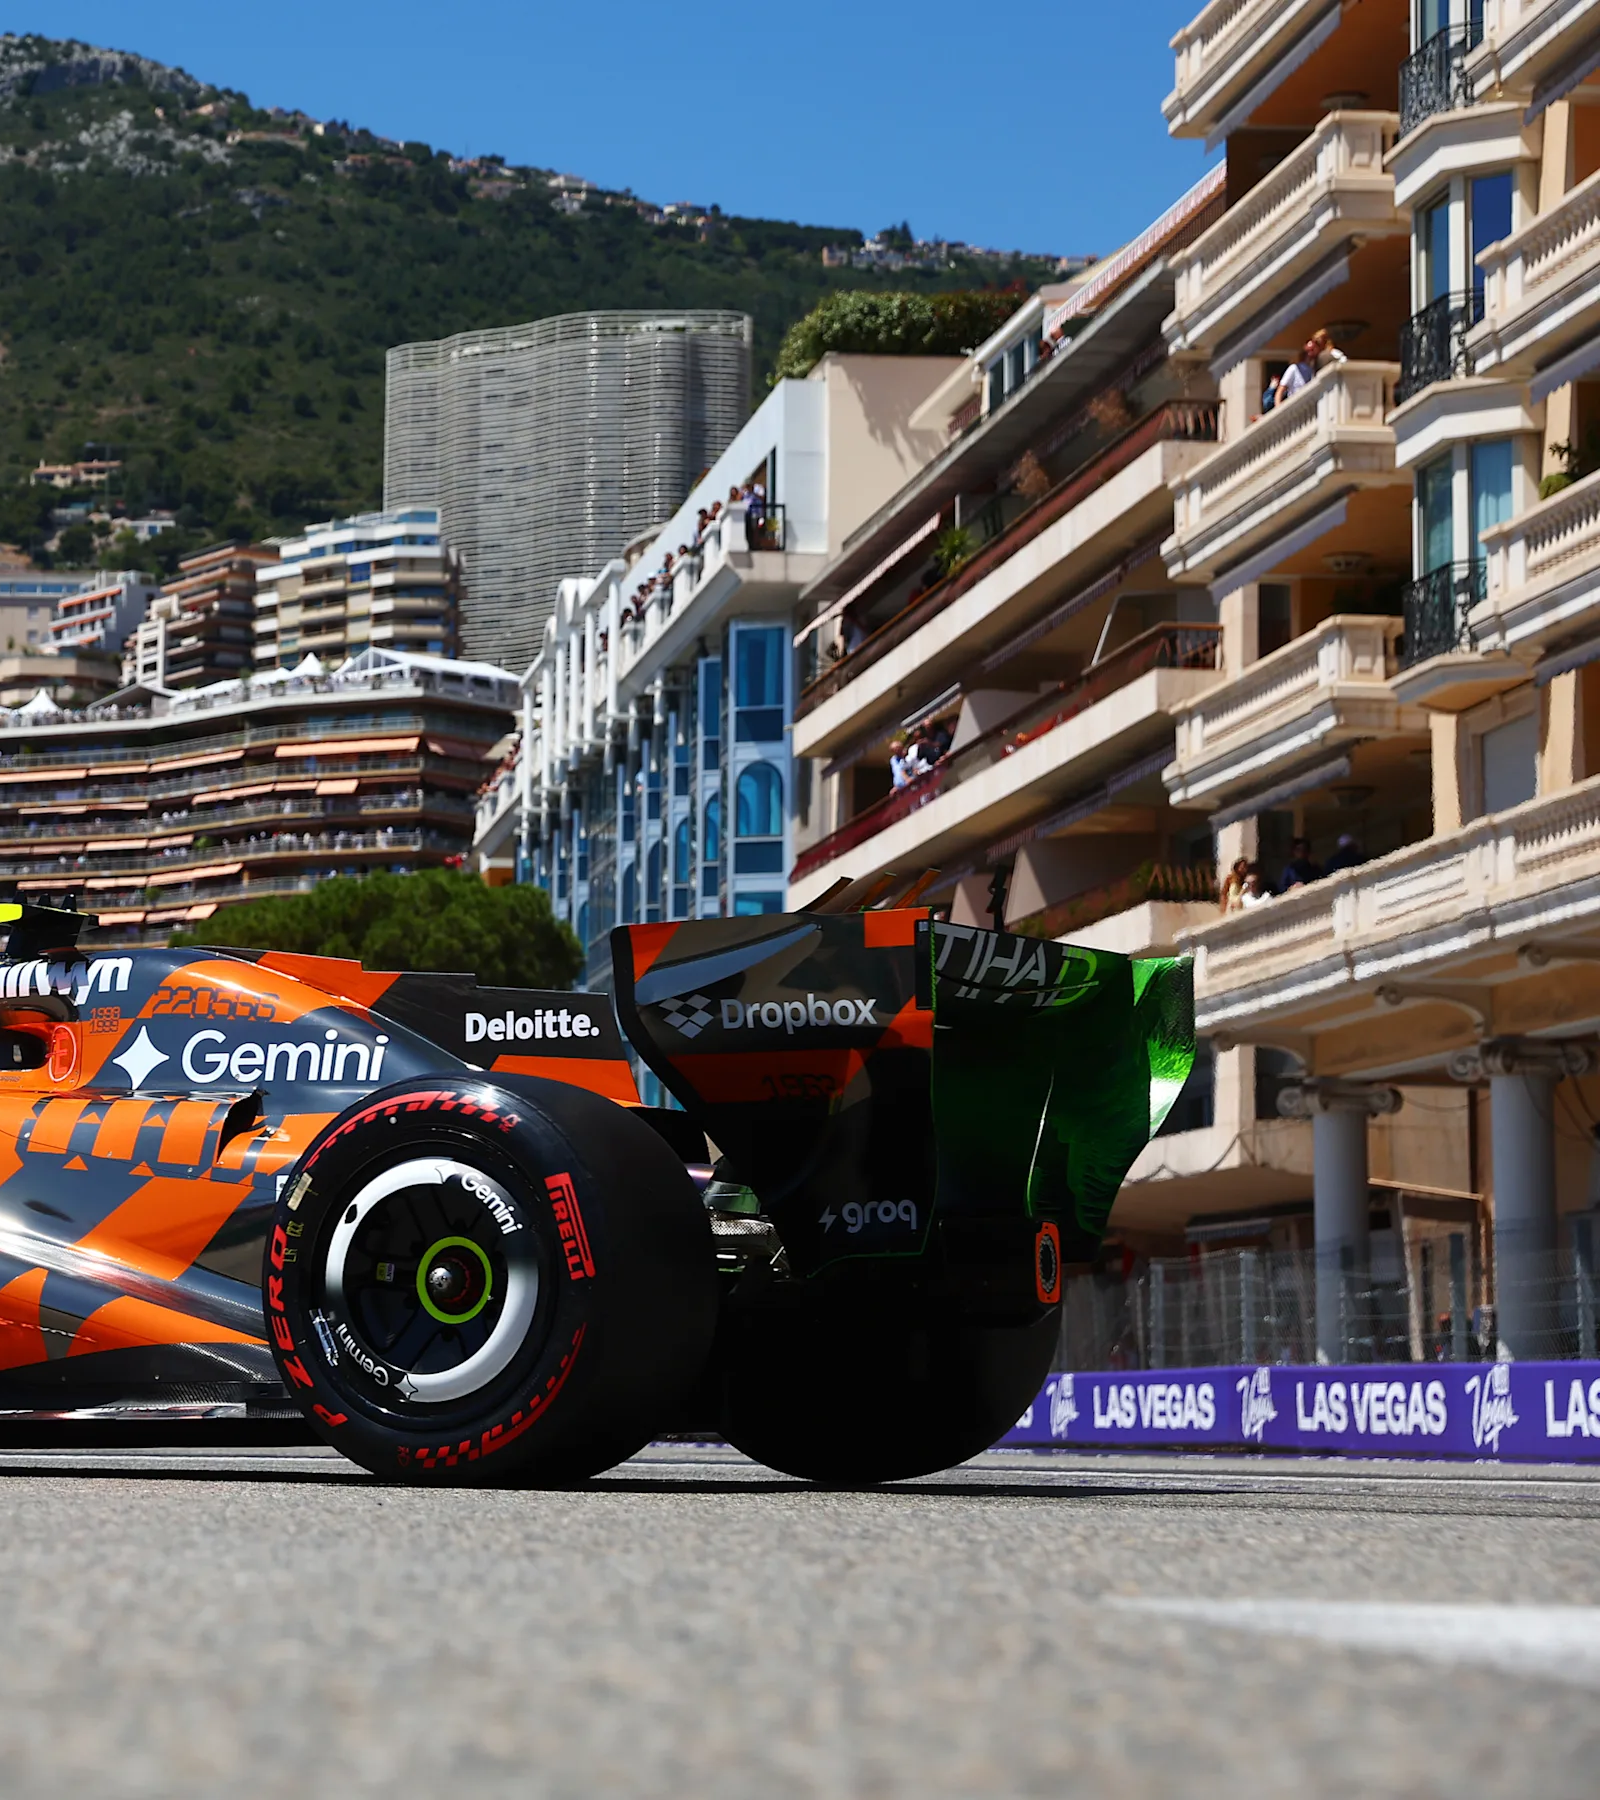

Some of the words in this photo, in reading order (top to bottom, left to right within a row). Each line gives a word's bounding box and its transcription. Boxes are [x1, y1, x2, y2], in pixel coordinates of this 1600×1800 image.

[934, 922, 1099, 1007] TIHAD
[465, 1008, 600, 1042] Deloitte.
[720, 993, 878, 1035] Dropbox
[181, 1028, 389, 1084] Gemini
[460, 1171, 523, 1235] Gemini
[544, 1171, 596, 1281] PIRELLI
[843, 1199, 918, 1234] groq
[268, 1224, 314, 1388] ZERO
[335, 1322, 389, 1387] Gemini
[1093, 1385, 1137, 1429] LAS
[1137, 1383, 1216, 1431] VEGAS
[1296, 1381, 1349, 1433] LAS
[1350, 1379, 1448, 1436] VEGAS
